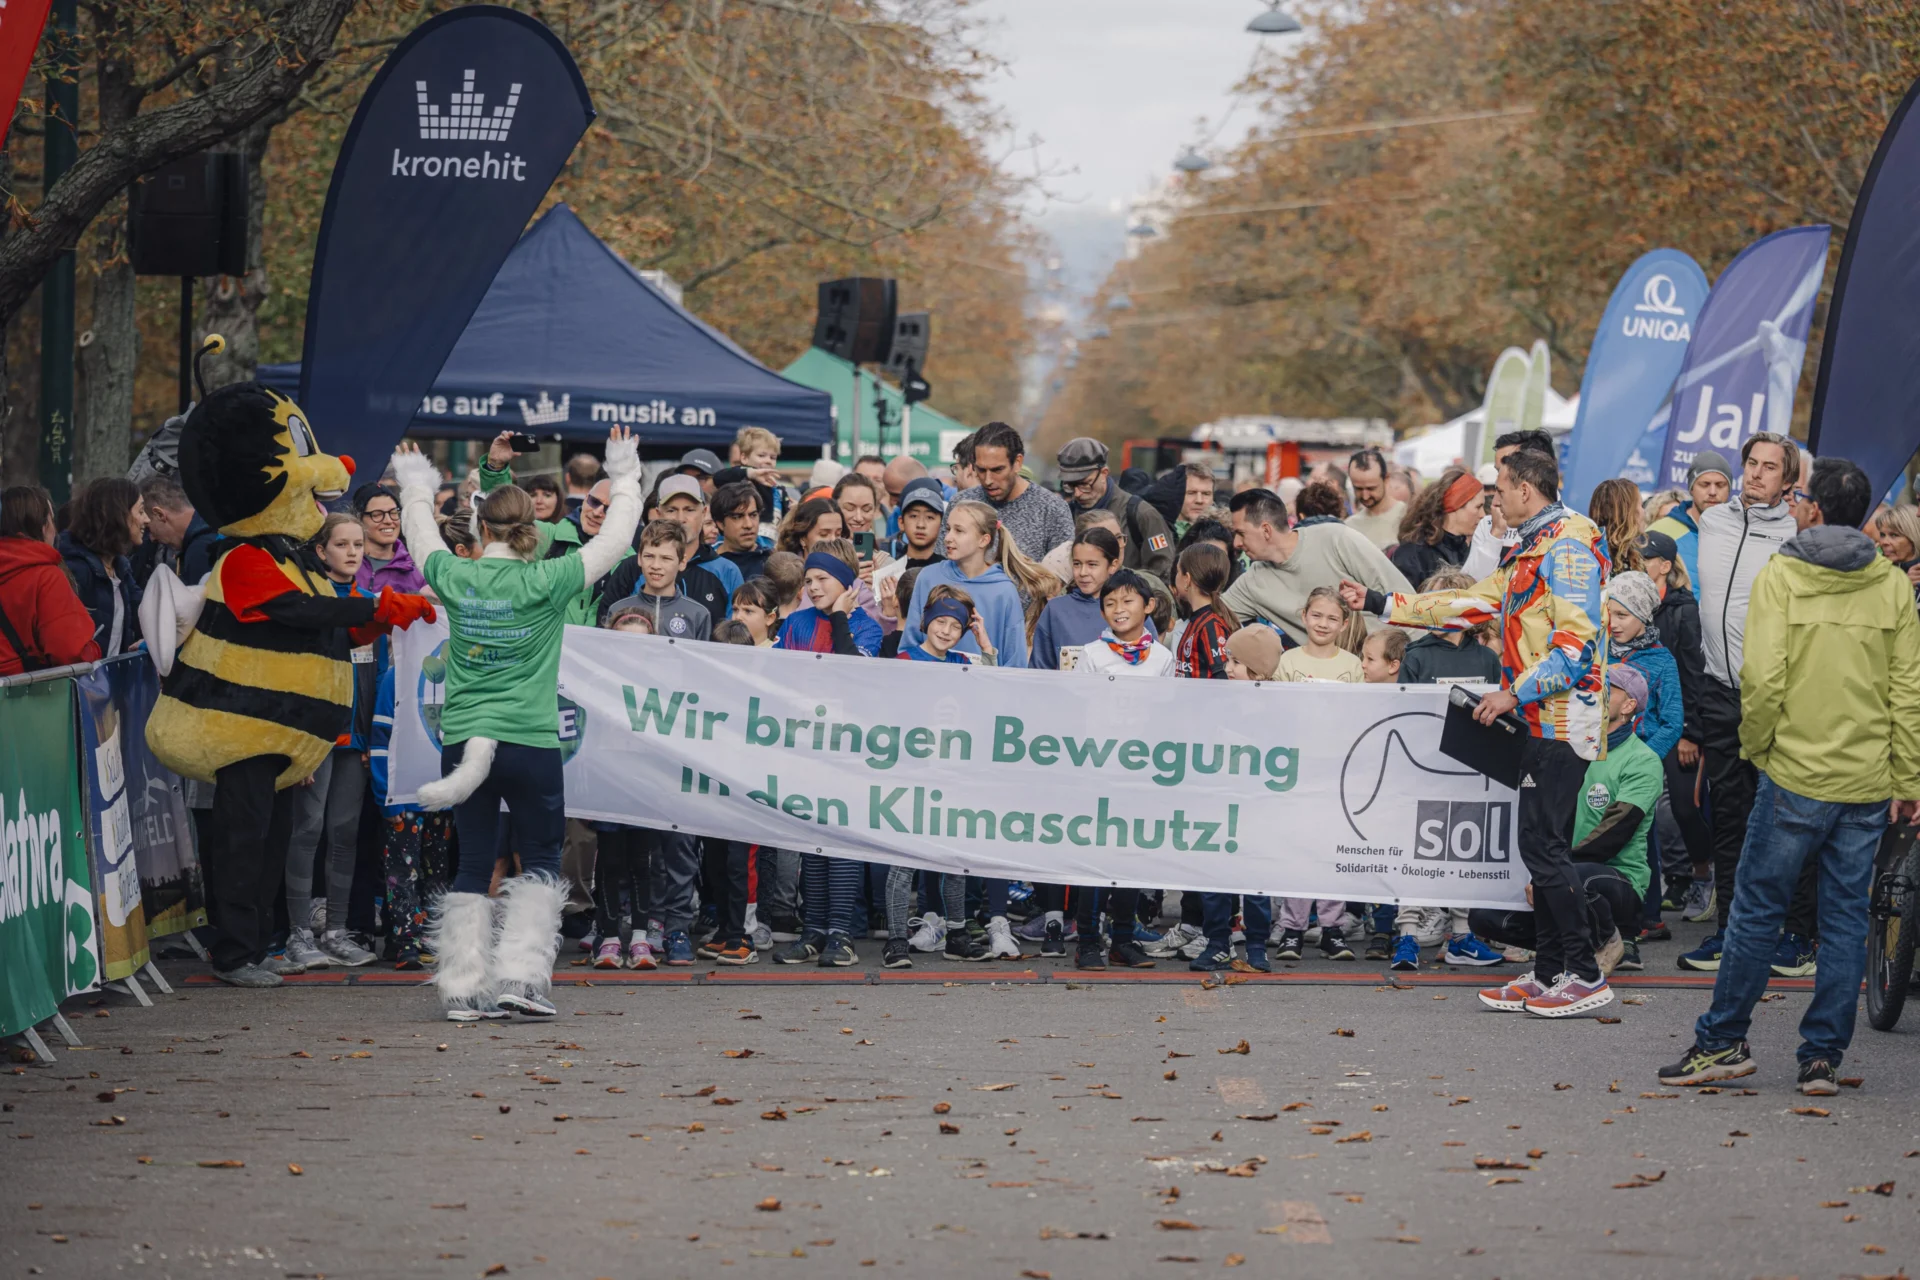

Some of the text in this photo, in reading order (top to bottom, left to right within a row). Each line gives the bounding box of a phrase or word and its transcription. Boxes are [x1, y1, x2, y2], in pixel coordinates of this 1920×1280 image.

[392, 148, 527, 182] kronehit
[1623, 315, 1691, 342] UNIQA
[454, 392, 504, 417] auf
[591, 400, 675, 425] musik
[681, 406, 716, 427] an
[1677, 384, 1765, 450] Ja!
[1673, 449, 1698, 464] zu
[622, 684, 1299, 792] Wir bringen Bewegung
[746, 774, 849, 827] den
[868, 785, 1239, 854] Klimaschutz!
[1416, 805, 1506, 860] sol
[1336, 845, 1403, 857] Menschen für
[1335, 863, 1510, 880] Solidarität Ökologie Lebensstil
